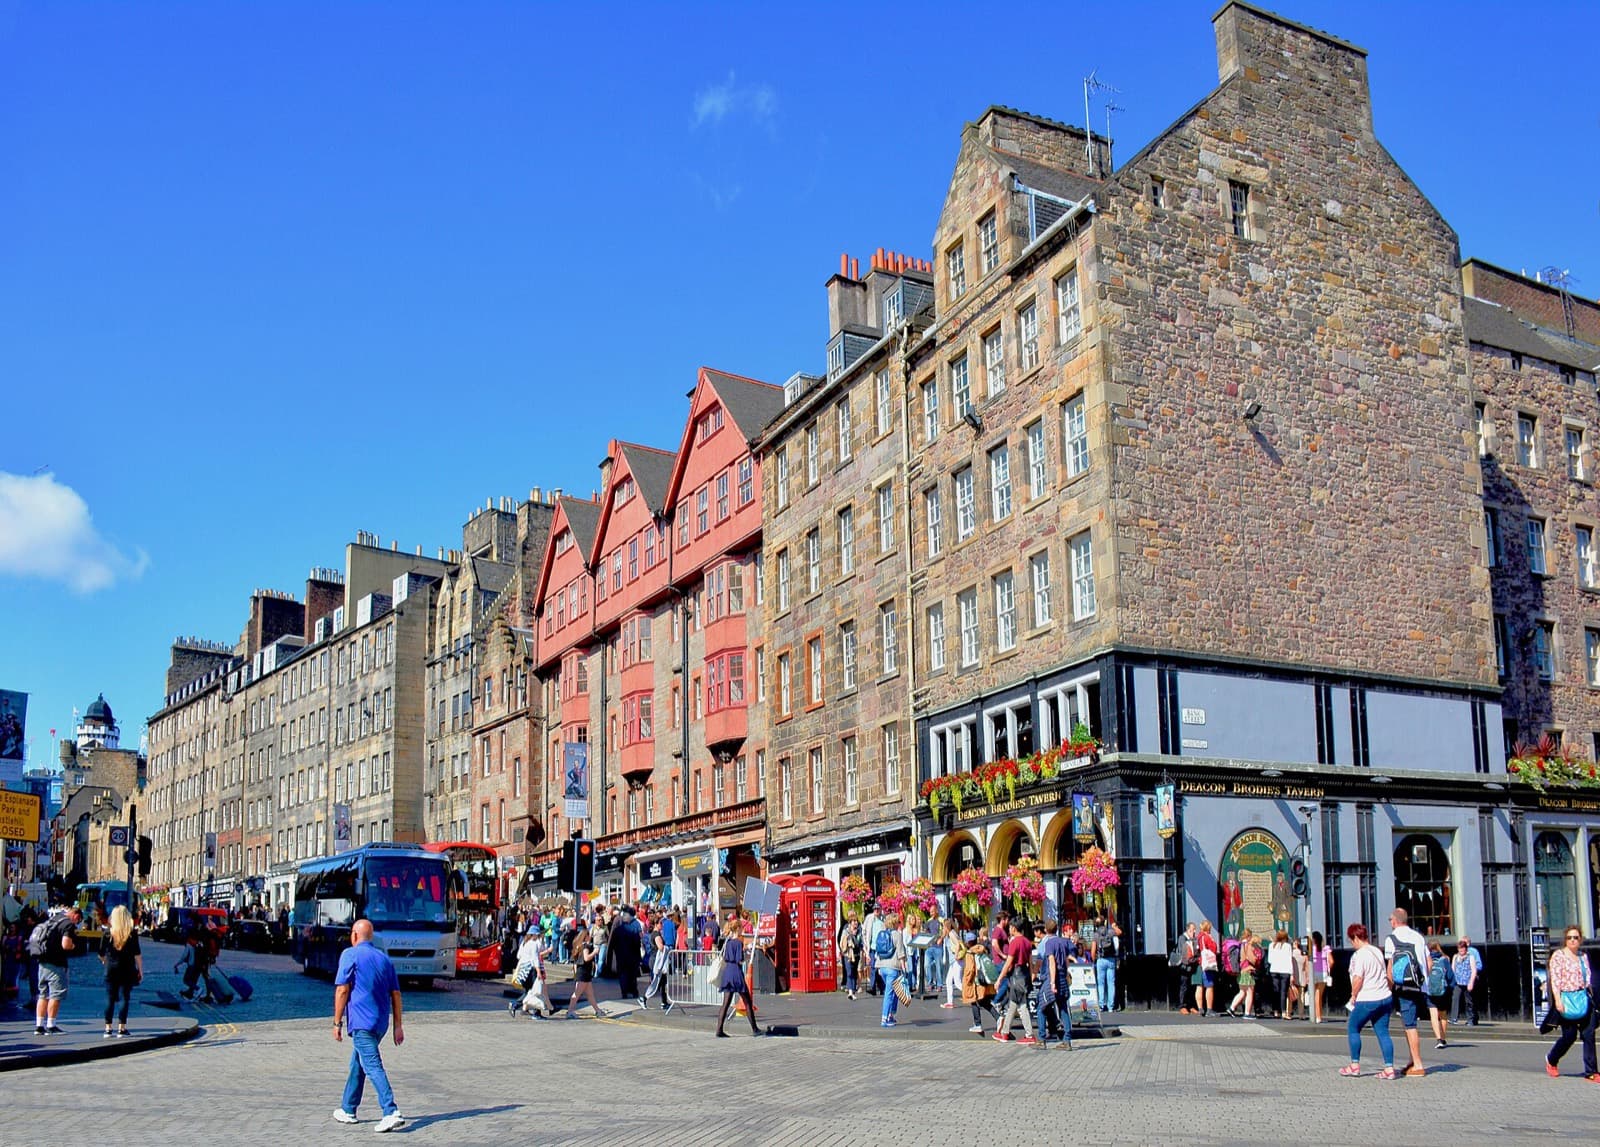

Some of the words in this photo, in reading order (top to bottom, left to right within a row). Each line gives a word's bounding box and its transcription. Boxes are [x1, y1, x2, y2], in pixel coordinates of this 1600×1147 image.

[1180, 780, 1226, 793] DEACON
[1233, 782, 1281, 796] BRODIE'S
[1285, 785, 1325, 797] TAVERN
[4, 793, 38, 807] Esplanade
[958, 806, 988, 820] DEACON
[991, 799, 1027, 815] BRODIE'S
[1028, 791, 1062, 806] TAVERN
[1538, 797, 1568, 808] DEACON
[2, 803, 16, 814] Park
[18, 807, 31, 817] and
[112, 832, 124, 840] 20
